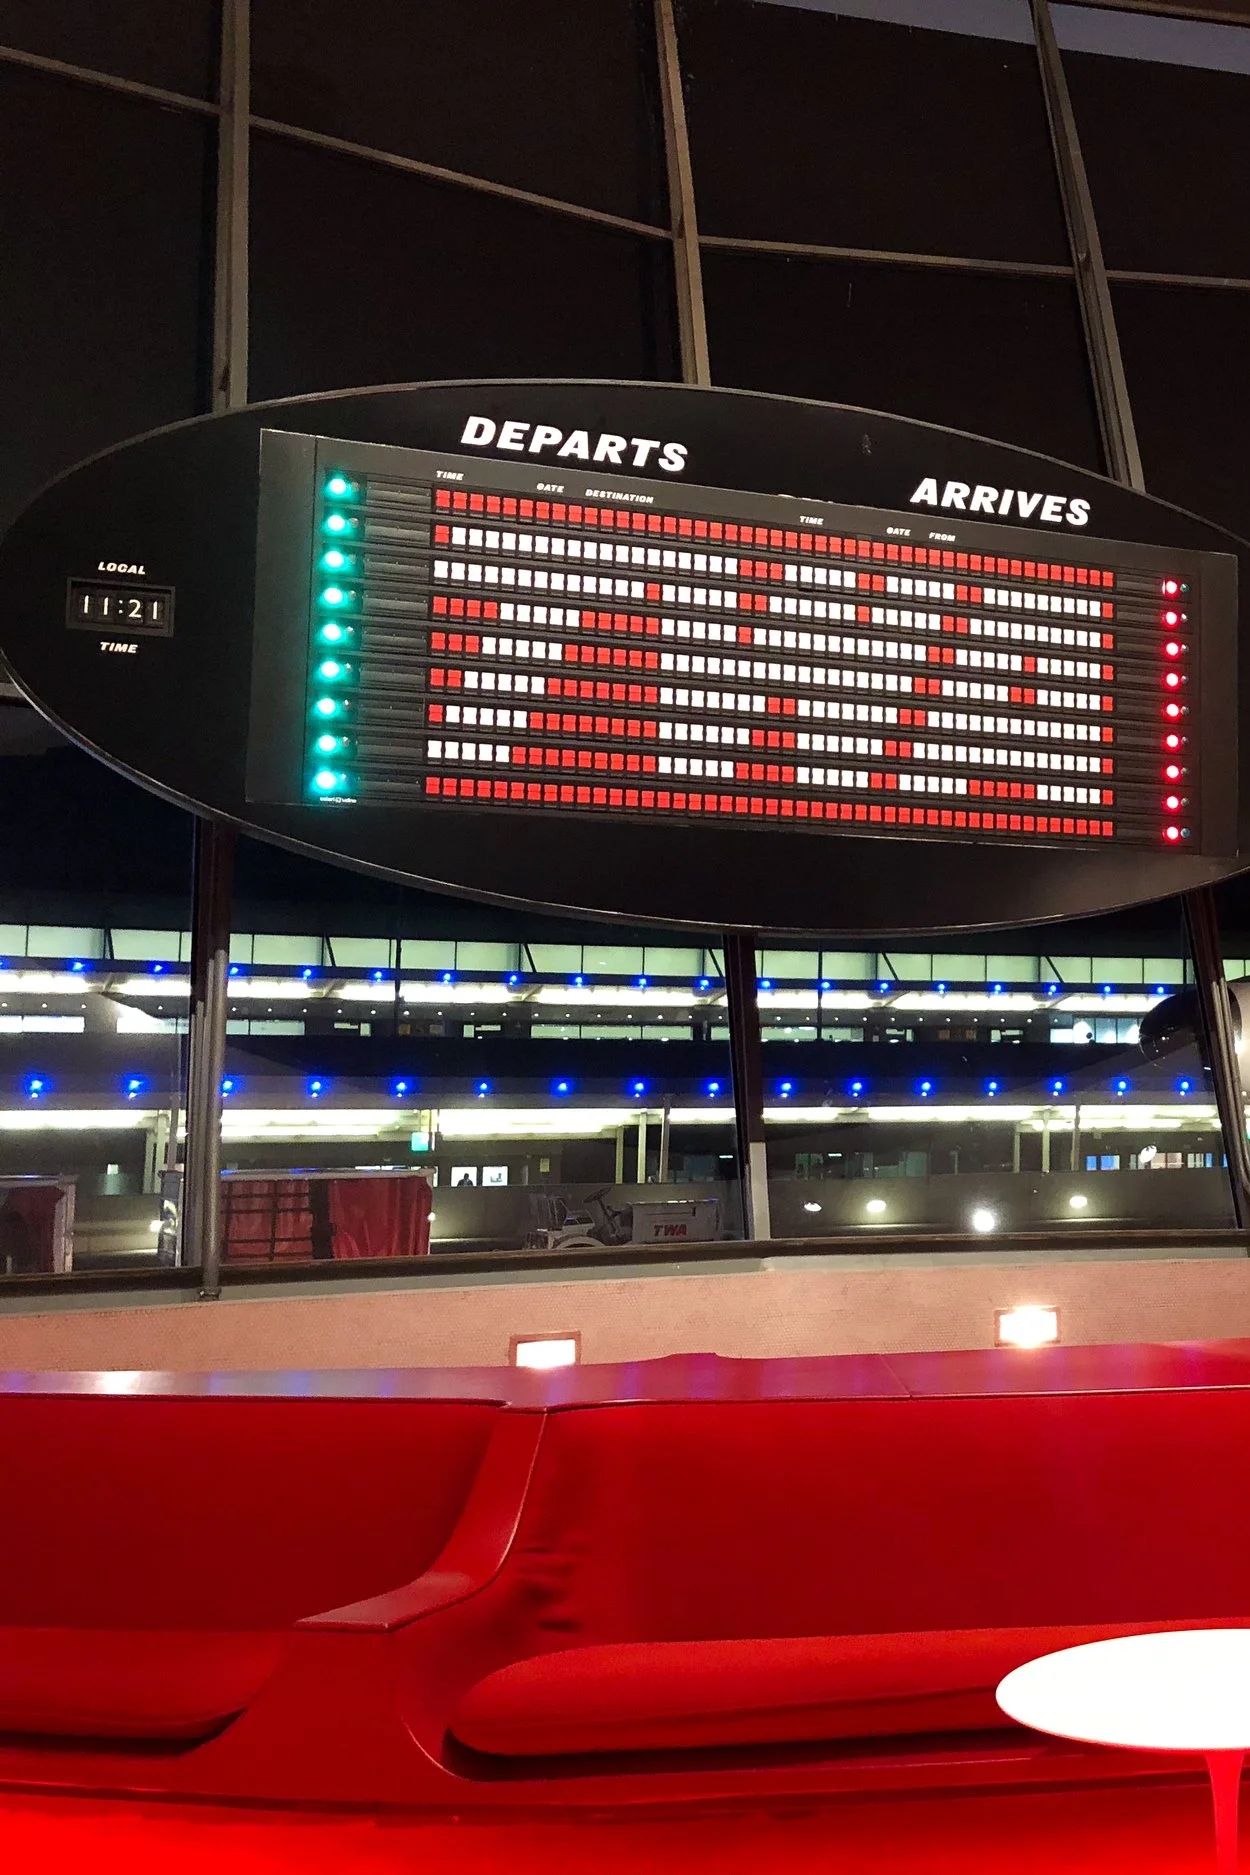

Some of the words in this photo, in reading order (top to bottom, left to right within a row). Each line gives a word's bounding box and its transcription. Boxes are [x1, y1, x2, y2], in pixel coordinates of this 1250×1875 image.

[461, 415, 688, 472] DEPARTS
[436, 470, 465, 481] TIME
[536, 483, 565, 493] GATE
[585, 488, 655, 504] DESTINATION
[909, 477, 1092, 526] ARRIVES
[799, 515, 825, 525] TIME
[886, 526, 911, 537] GATE
[929, 532, 956, 542] FROM
[98, 561, 146, 575] LOCAL
[83, 595, 159, 620] 11:21
[100, 641, 139, 653] TIME
[653, 1223, 687, 1237] TWA
